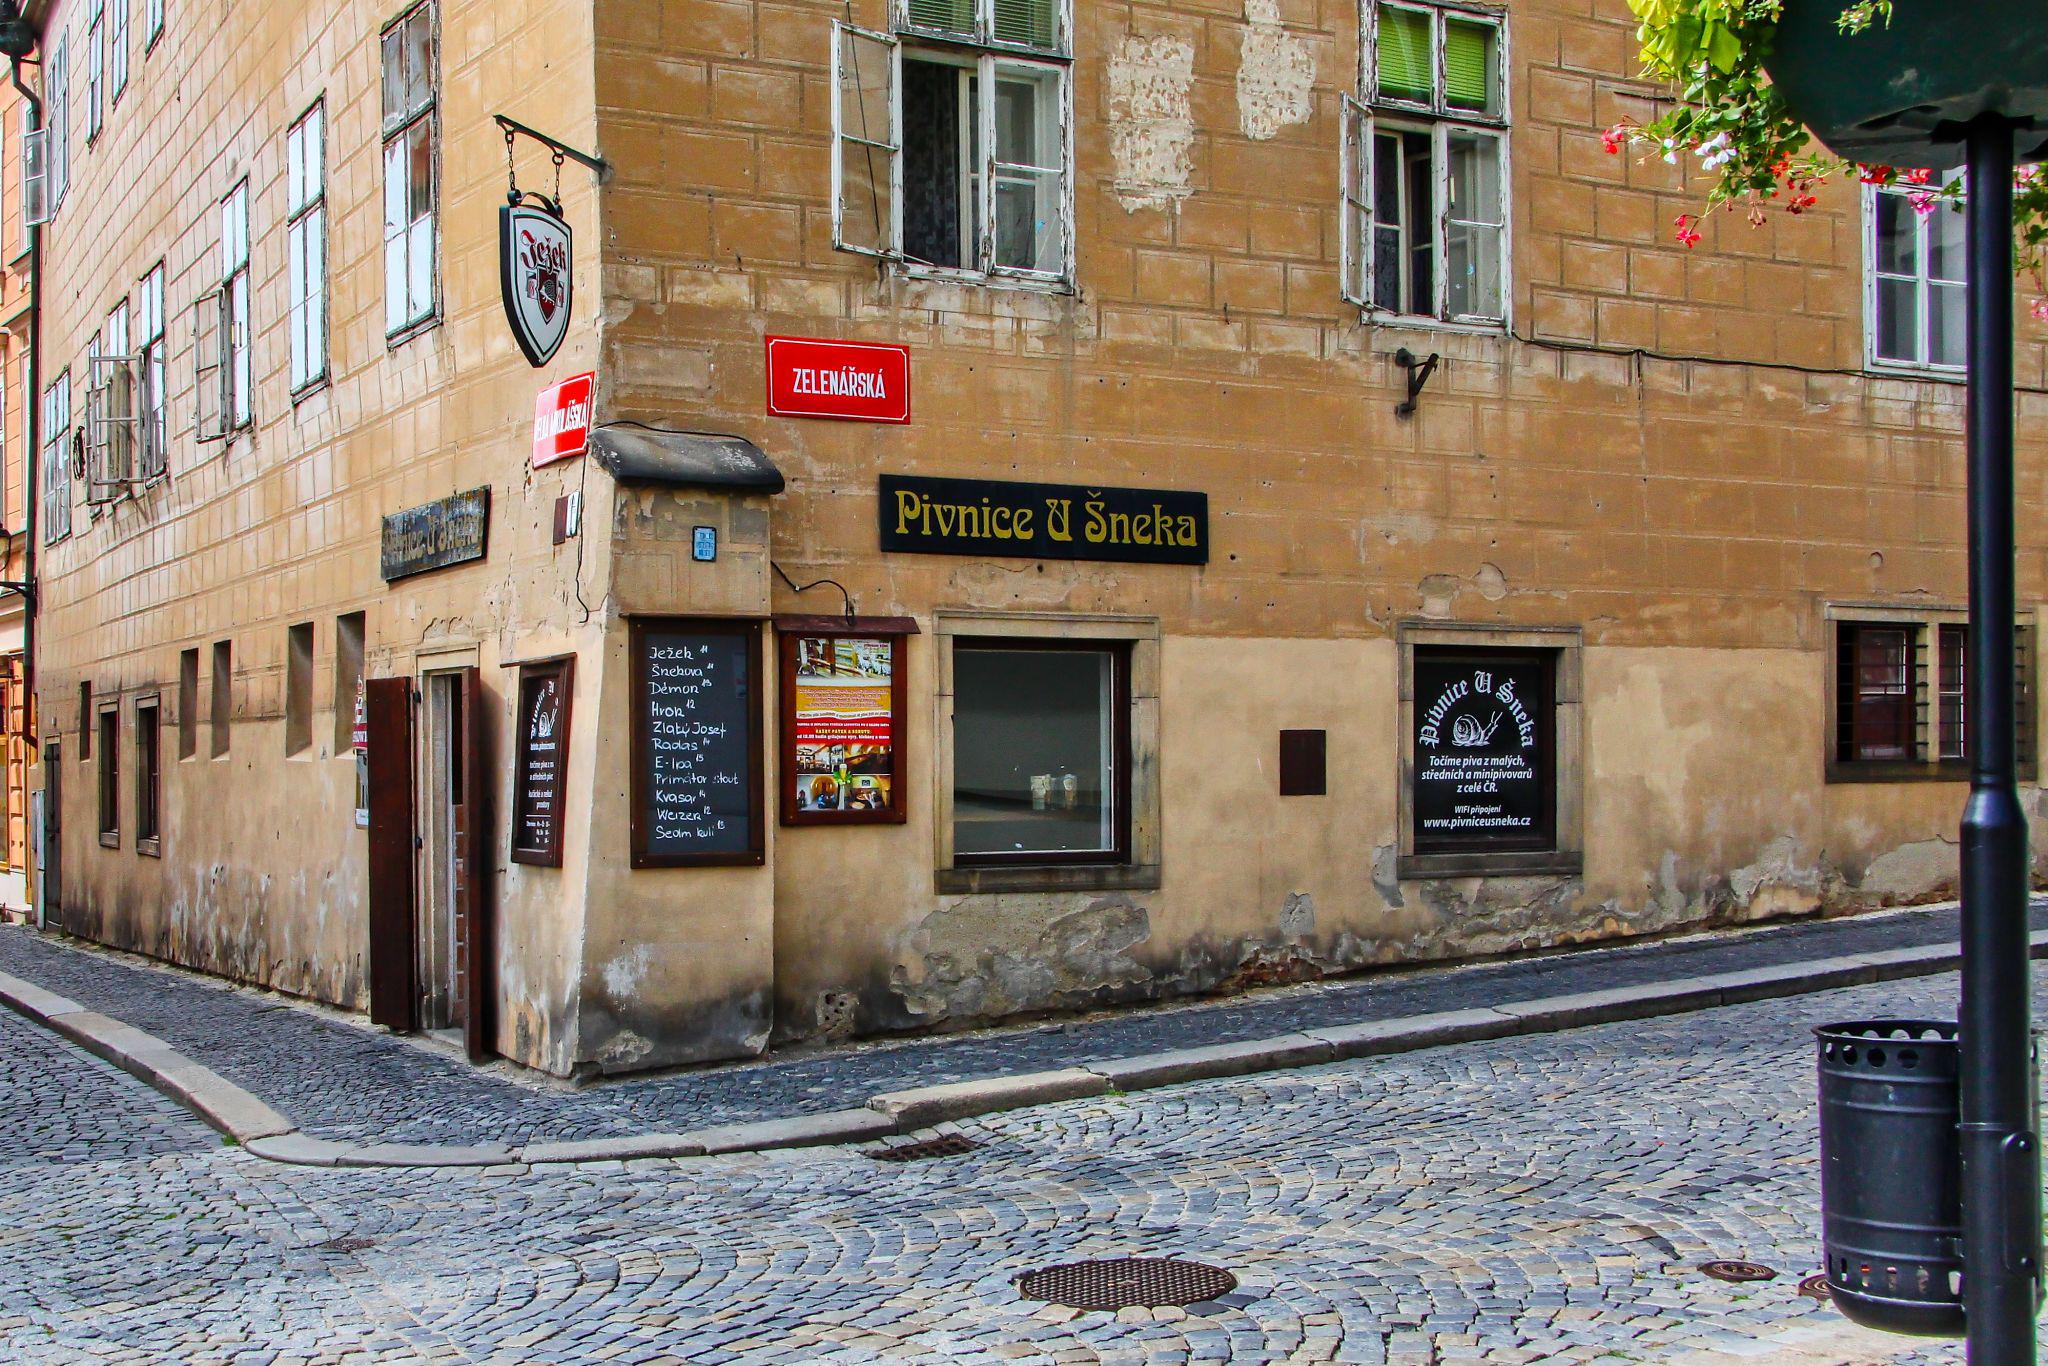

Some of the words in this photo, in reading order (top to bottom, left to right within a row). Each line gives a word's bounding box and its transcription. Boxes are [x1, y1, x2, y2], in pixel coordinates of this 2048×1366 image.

[520, 229, 567, 275] Ježek
[792, 365, 886, 399] ZELENÁŘSKÁ
[894, 490, 1034, 540] Pivnice
[1045, 498, 1073, 542] U
[1084, 489, 1198, 547] Šneka
[649, 645, 694, 660] Ježek
[648, 681, 699, 694] Démon
[686, 699, 696, 709] 12
[1419, 679, 1469, 749] Pivnice
[1474, 670, 1493, 694] U
[1495, 677, 1535, 748] Šneka
[652, 721, 690, 738] Zlatý
[691, 721, 727, 739] Josef
[651, 737, 698, 751] Radas
[1429, 755, 1461, 767] Točíme
[1462, 755, 1483, 768] piva
[1490, 755, 1525, 770] malých,
[1421, 768, 1464, 780] středních
[1465, 771, 1472, 779] a
[1473, 767, 1533, 782] minipivovarů
[1456, 785, 1462, 793] z
[1463, 782, 1482, 793] celé
[1482, 780, 1498, 793] ČR.
[655, 789, 697, 804] Kvasar
[703, 805, 712, 815] 12
[1454, 806, 1470, 814] WIFI
[1470, 805, 1501, 815] připojení
[1423, 815, 1531, 829] www.pivniceusneka.cz
[655, 825, 692, 839] Sedm
